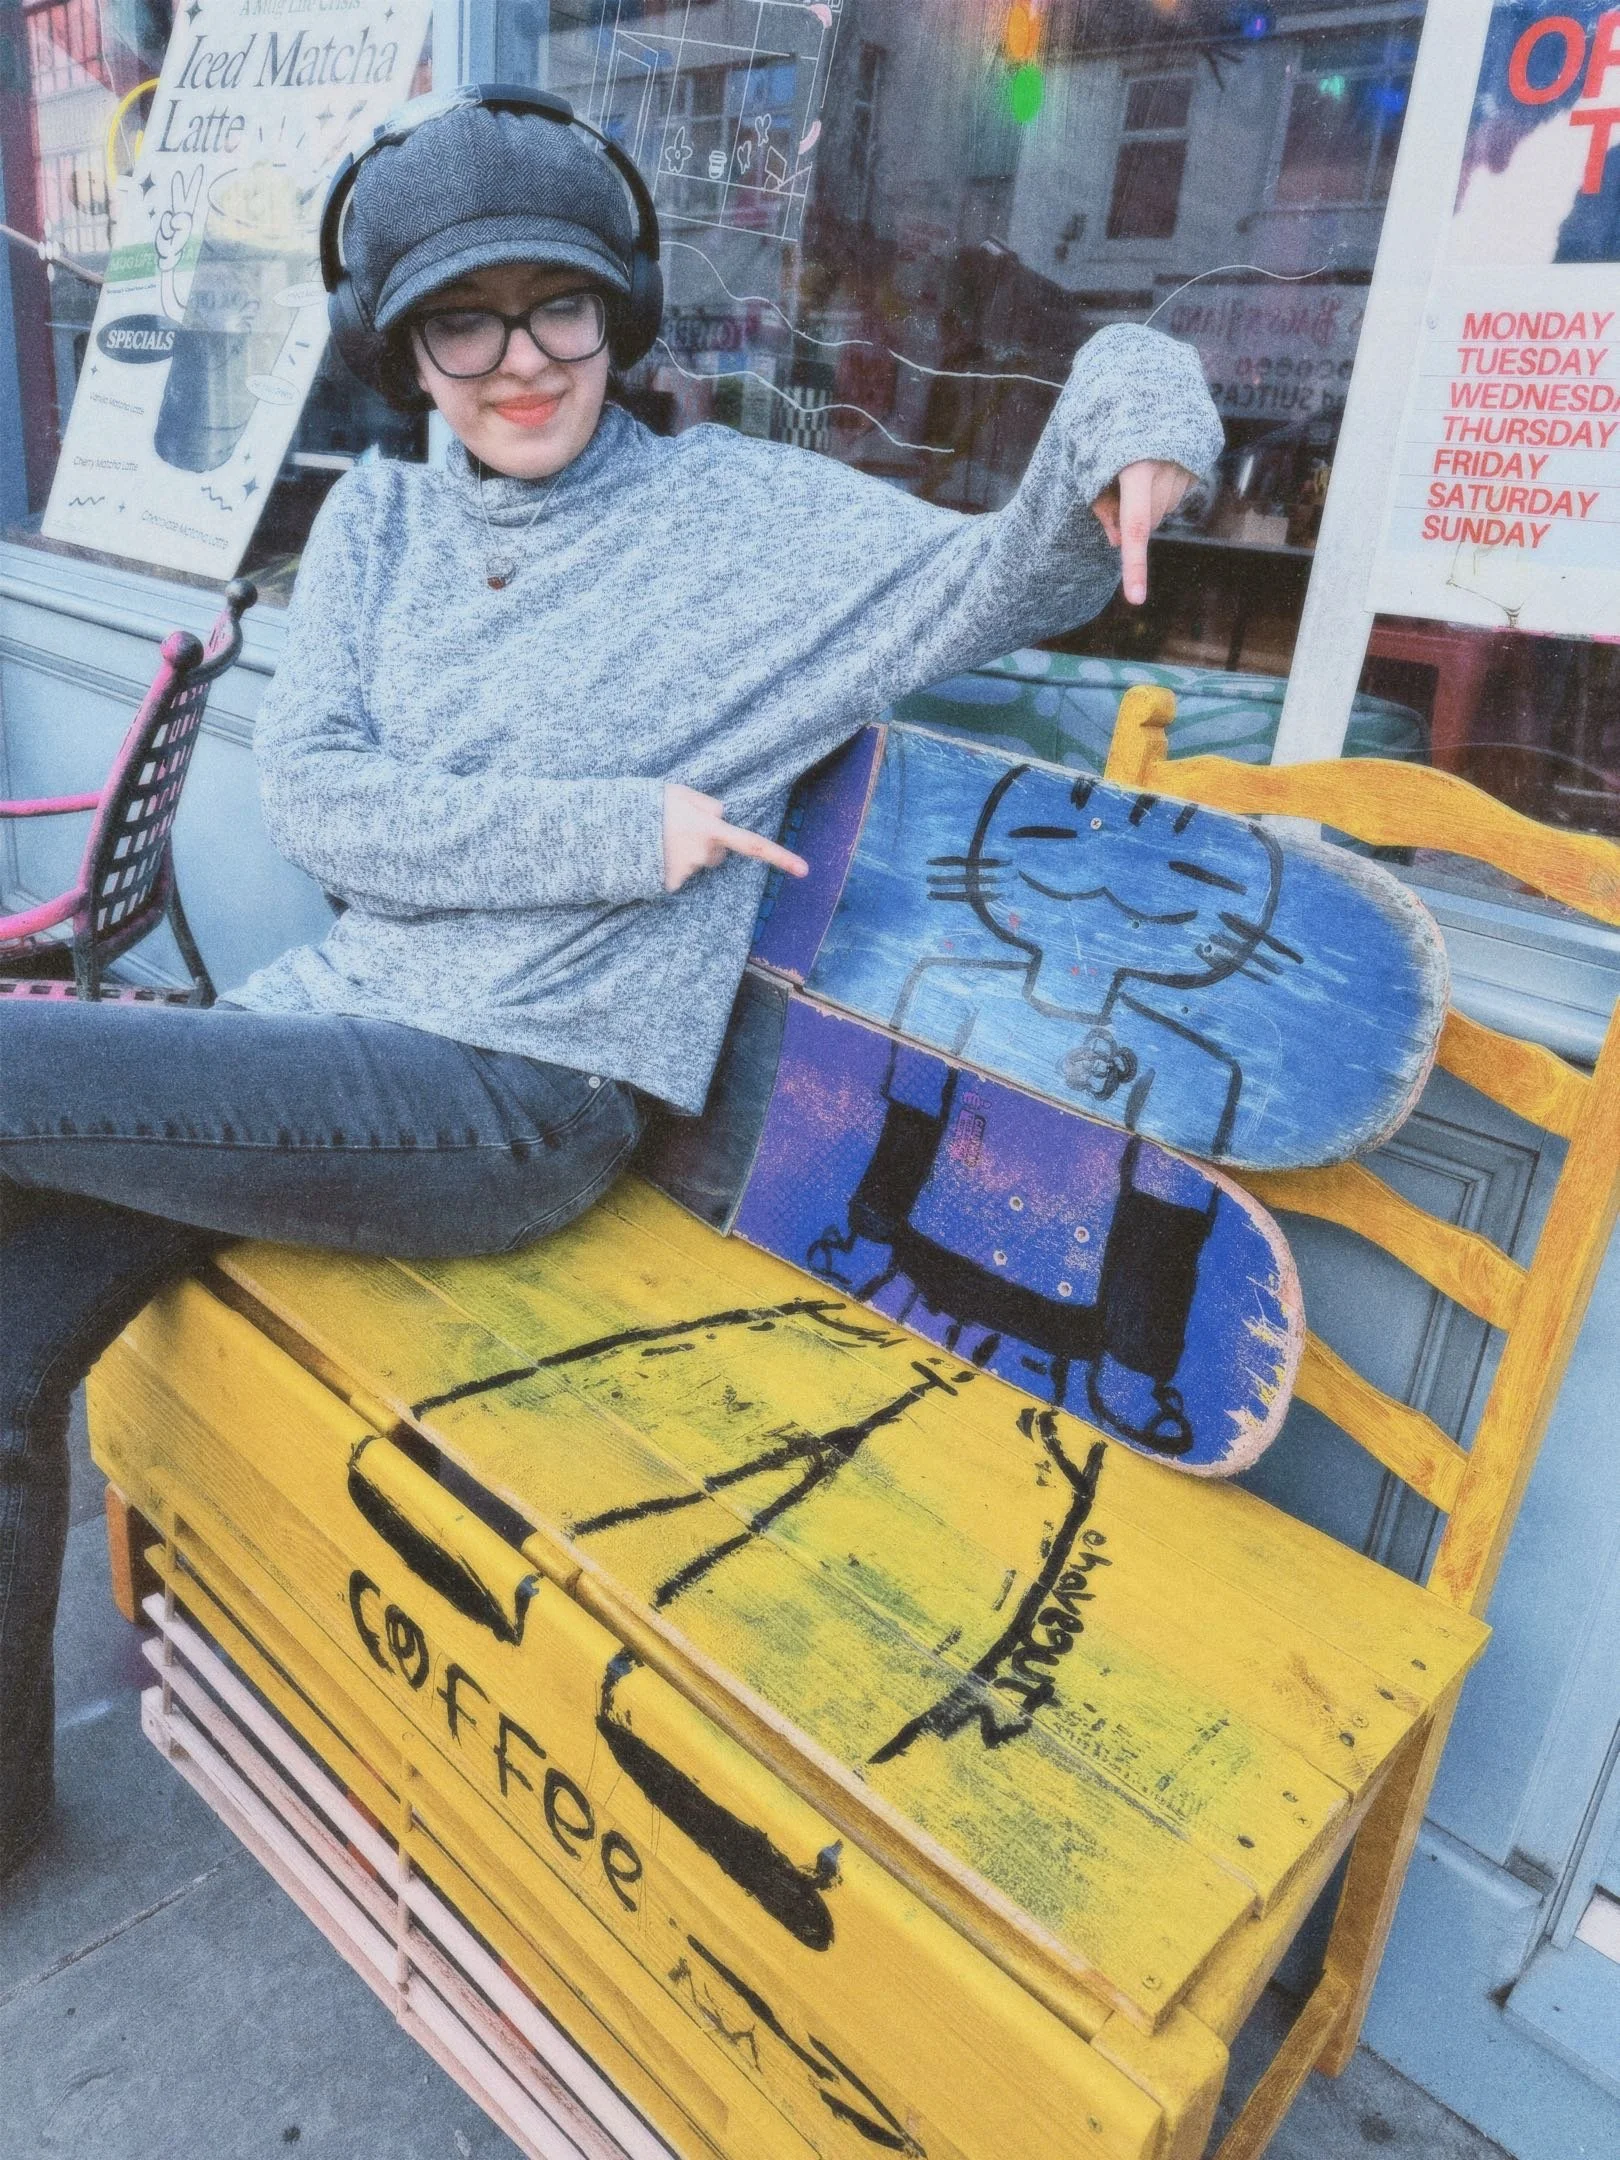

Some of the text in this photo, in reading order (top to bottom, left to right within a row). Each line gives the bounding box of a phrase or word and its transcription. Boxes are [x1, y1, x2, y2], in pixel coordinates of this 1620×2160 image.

[174, 26, 399, 90] Iced Matcha
[155, 99, 246, 153] Latte
[106, 331, 175, 350] SPECIALS
[1462, 311, 1615, 340] MONDAY
[1457, 347, 1609, 376] TUESDAY
[1450, 382, 1620, 413] WEDNESD
[1443, 415, 1620, 448] THURSDAY
[1433, 449, 1550, 479] FRIDAY
[1427, 481, 1600, 518] SATURDAY
[1421, 514, 1551, 549] SUNDAY
